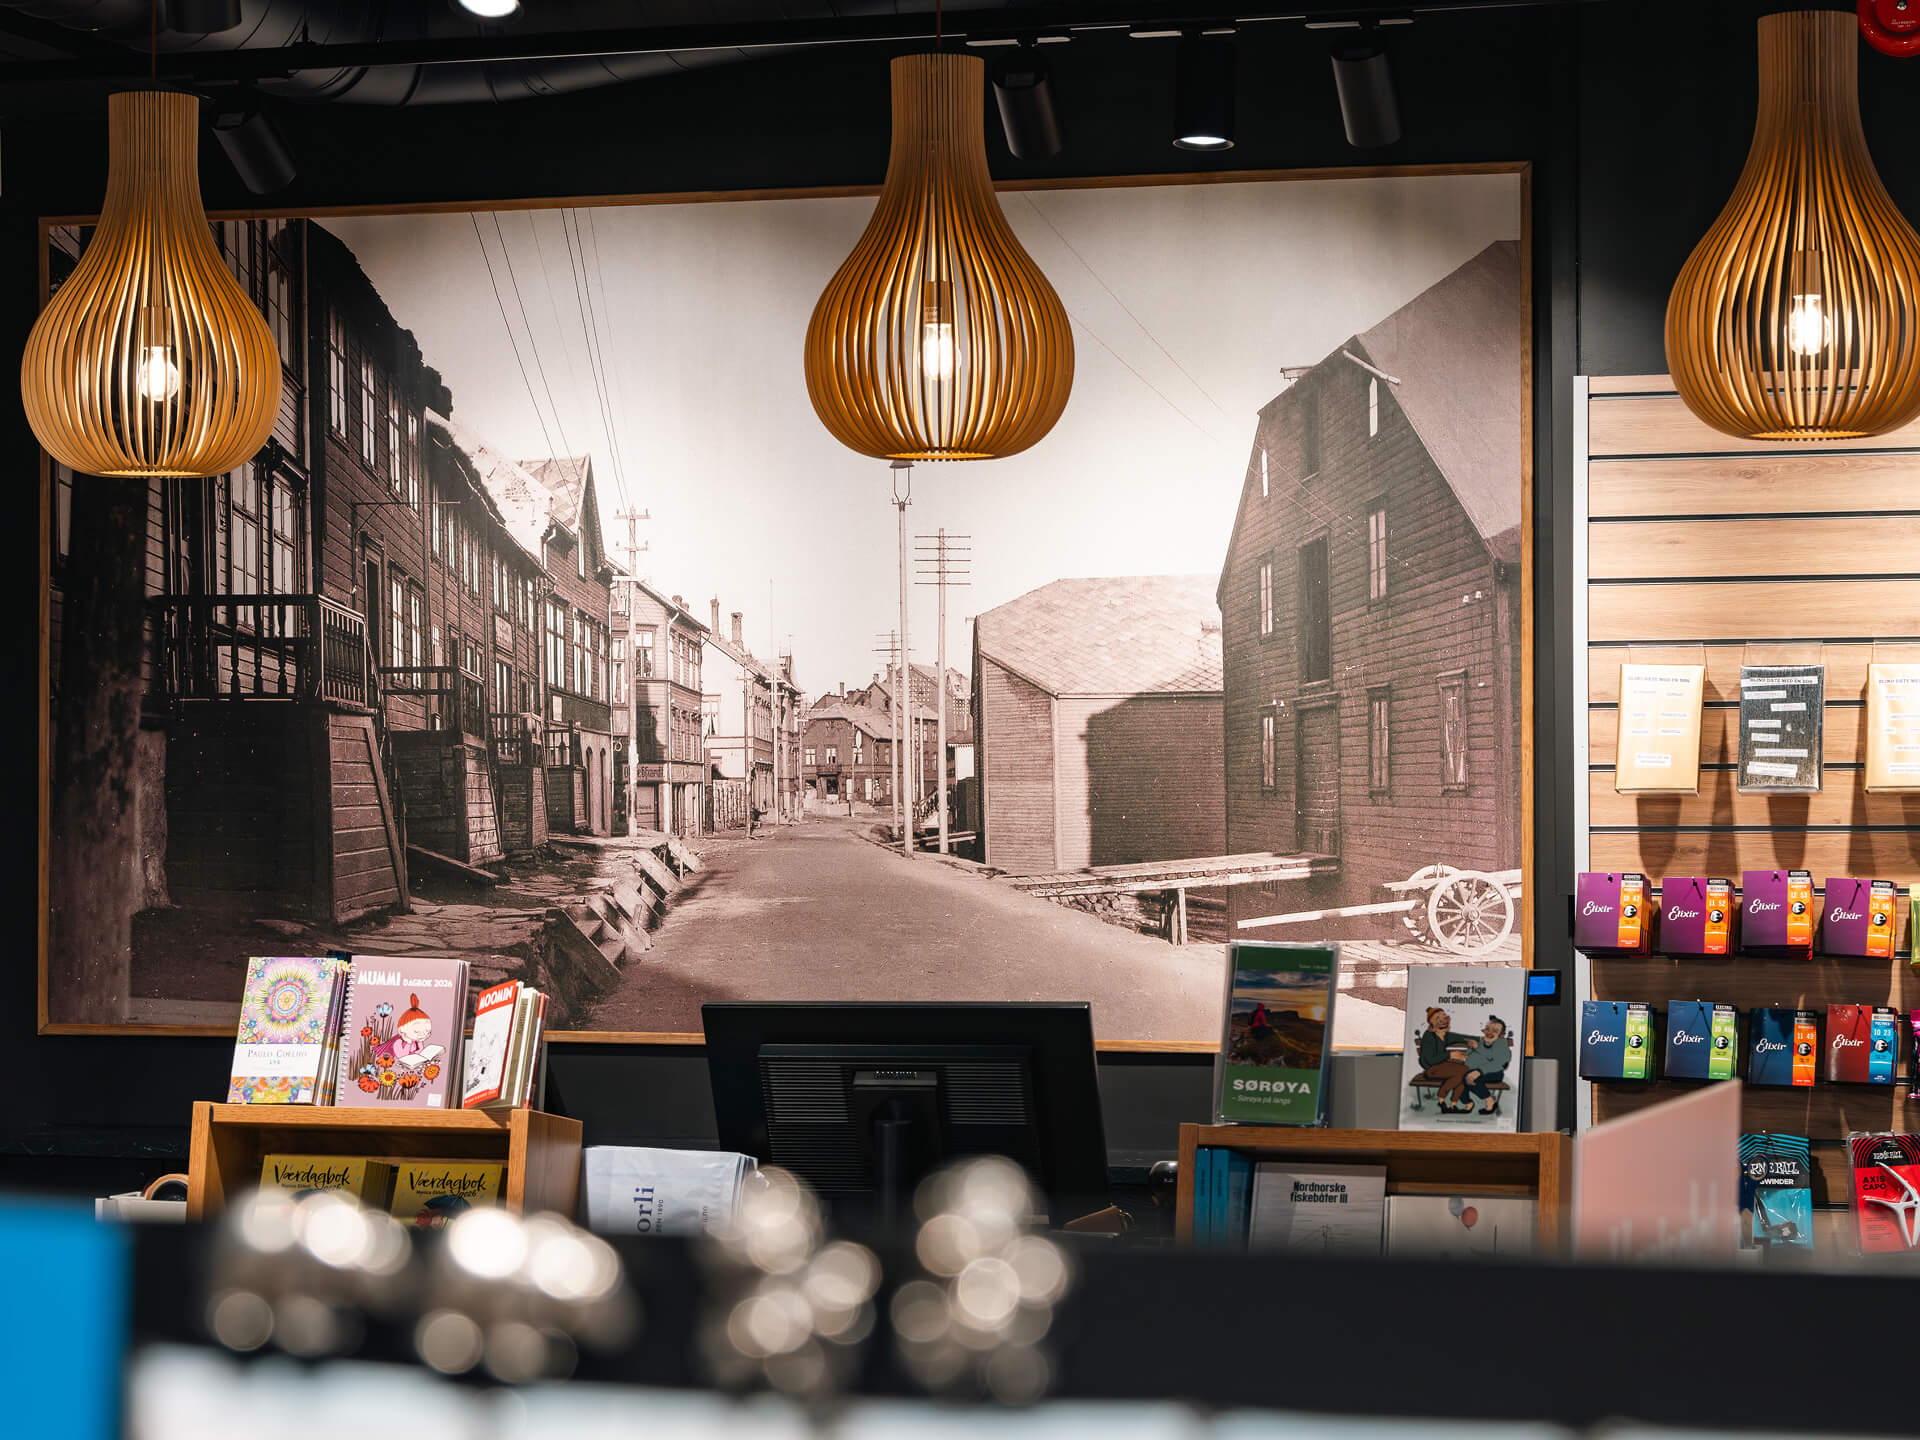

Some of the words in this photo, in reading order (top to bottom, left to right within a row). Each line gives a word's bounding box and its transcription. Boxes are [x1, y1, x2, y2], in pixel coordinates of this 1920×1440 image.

[1583, 900, 1613, 916] Elixir
[1668, 905, 1699, 921] Elixir
[1749, 898, 1781, 914] Elixir
[1830, 907, 1862, 922] Elixir
[358, 970, 400, 987] MUMMI
[1447, 984, 1462, 994] Den
[1463, 985, 1487, 996] artige
[478, 985, 514, 1011] MOOMIN
[1438, 995, 1494, 1007] nordlendingen
[1588, 1030, 1618, 1045] Elixir
[1673, 1030, 1704, 1045] Elixir
[1832, 1034, 1864, 1049] Elixir
[1756, 1038, 1787, 1053] Elixir
[1232, 1079, 1311, 1094] SØRØYA
[1743, 1161, 1775, 1175] RNE
[1775, 1161, 1800, 1175] BALL
[274, 1164, 351, 1190] Værdagbok
[409, 1171, 487, 1197] Værdagbok
[1863, 1175, 1886, 1183] AXIS
[1293, 1181, 1347, 1193] Nordnorske
[1863, 1183, 1887, 1191] CAPO
[1290, 1191, 1338, 1203] fiskebåter
[1339, 1192, 1349, 1203] III
[633, 1187, 655, 1232] orli
